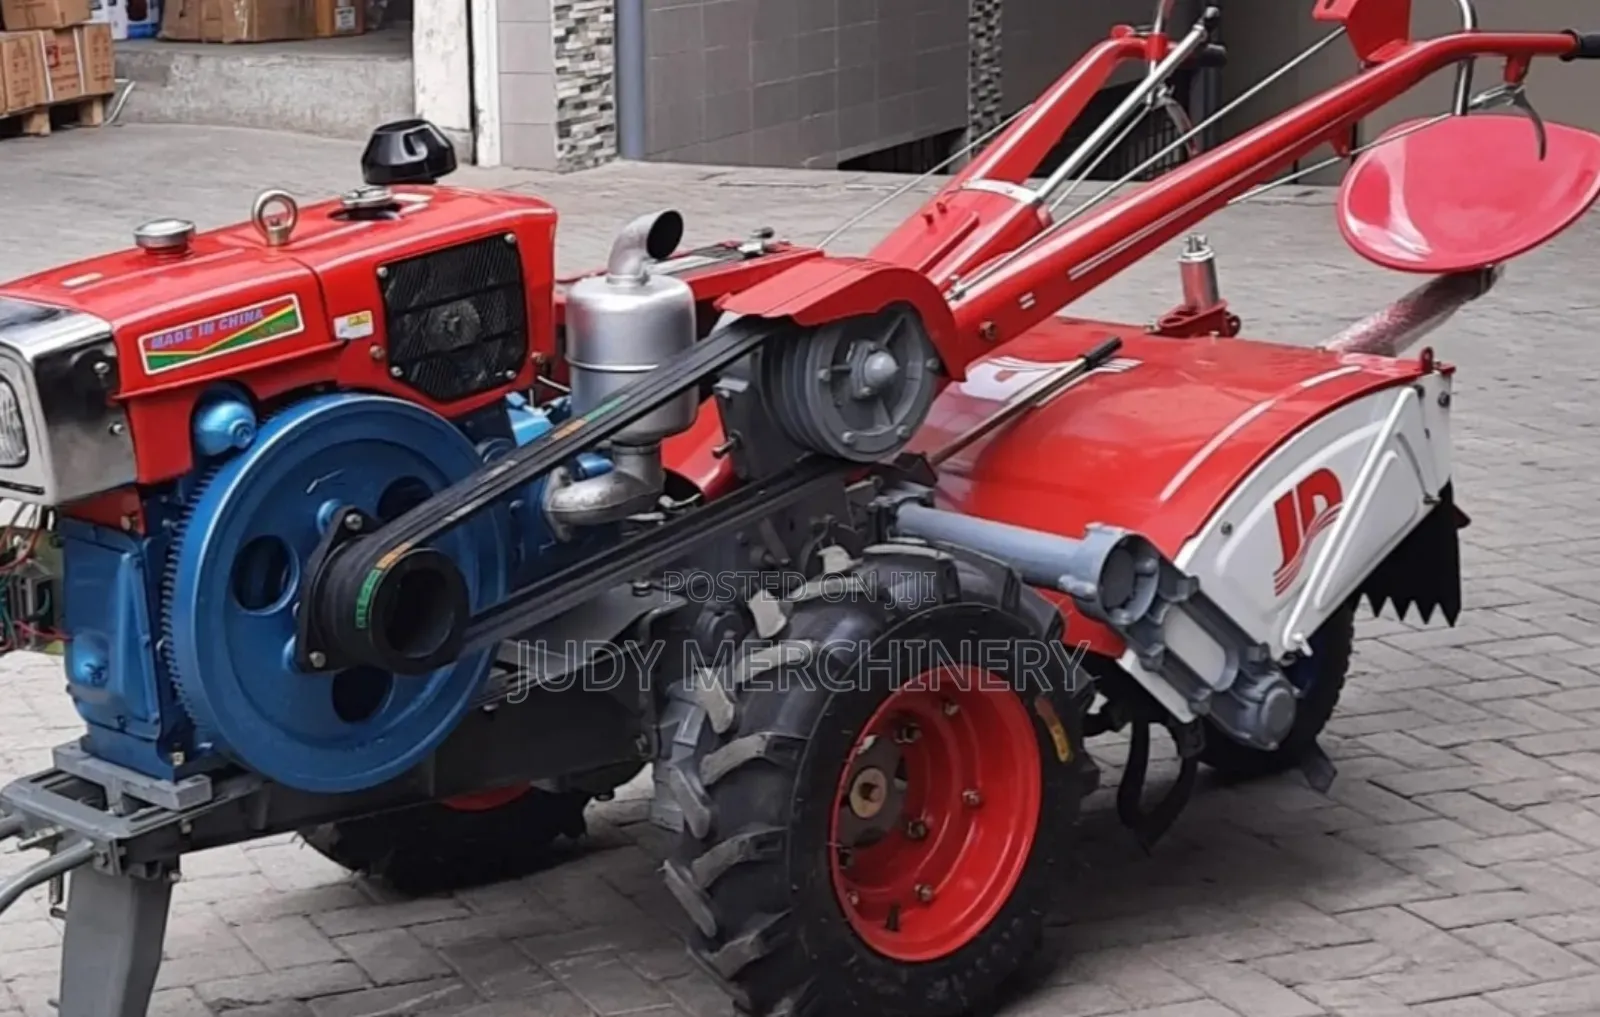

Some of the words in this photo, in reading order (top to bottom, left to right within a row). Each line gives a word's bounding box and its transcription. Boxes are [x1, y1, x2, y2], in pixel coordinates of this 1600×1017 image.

[151, 329, 193, 349] MADE
[198, 322, 215, 337] IN
[218, 309, 264, 330] CHINA
